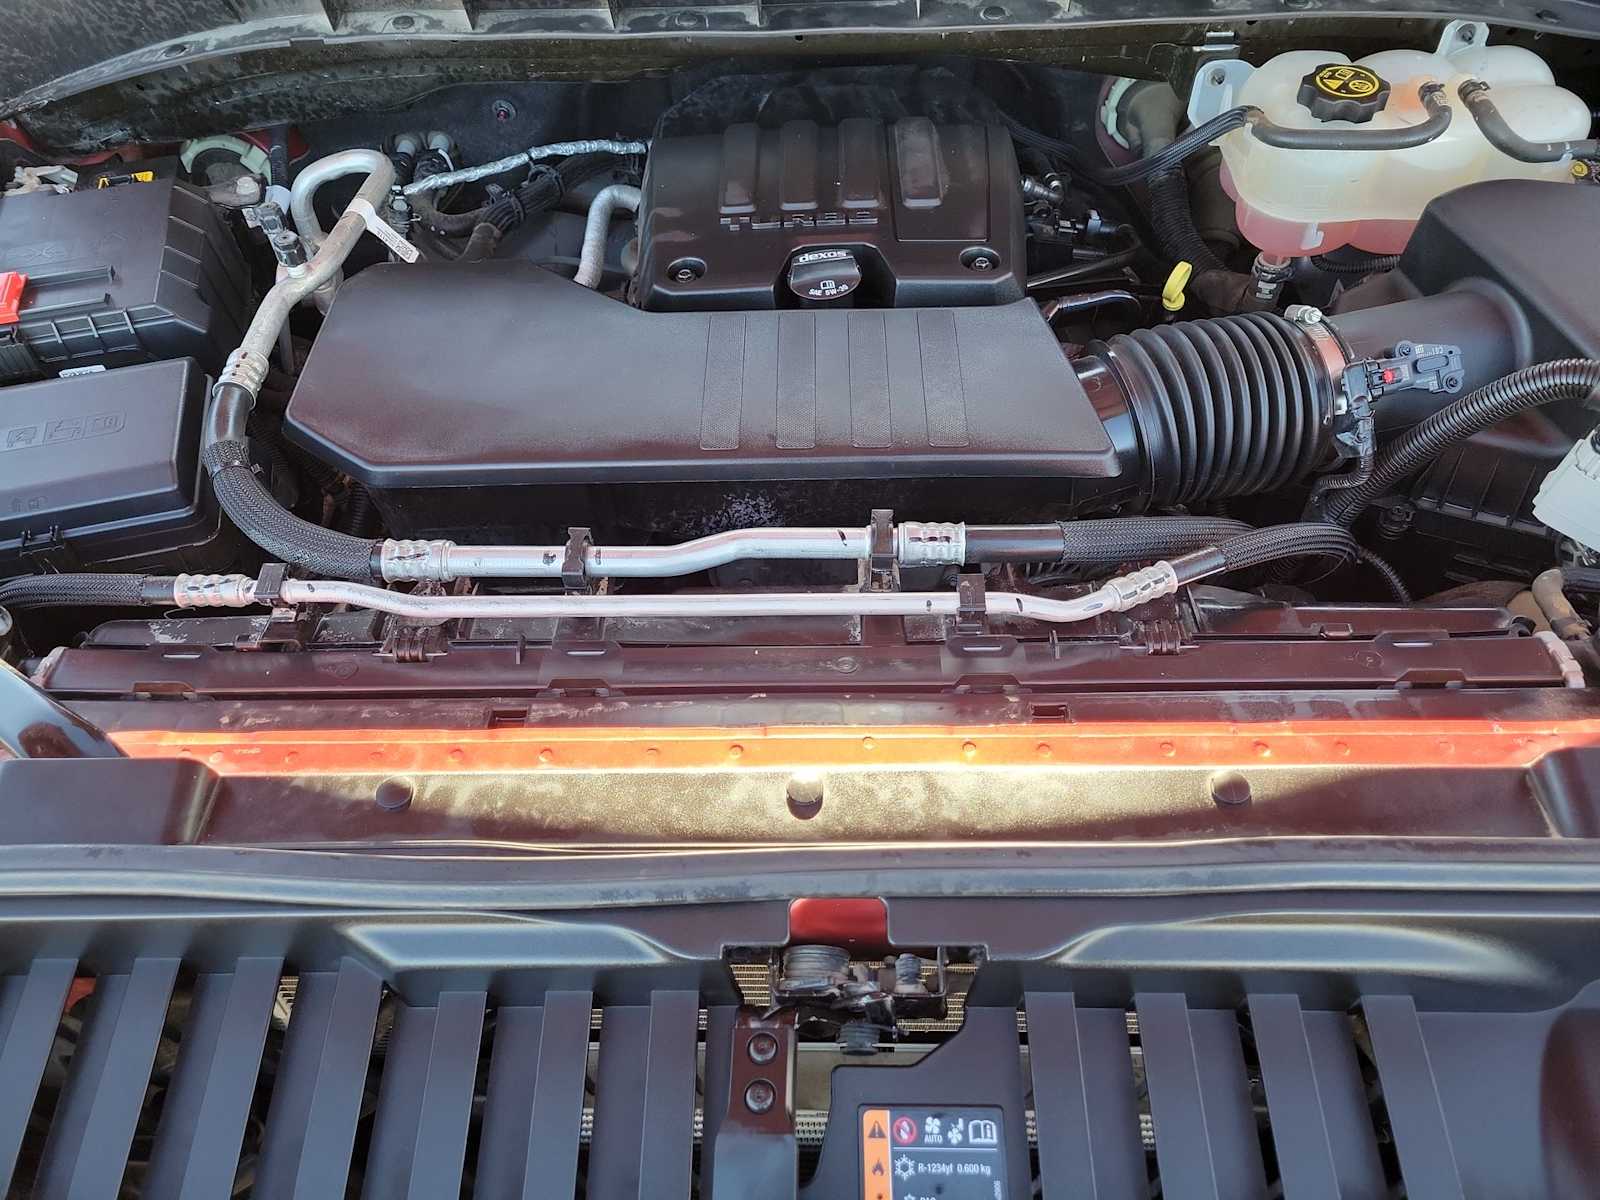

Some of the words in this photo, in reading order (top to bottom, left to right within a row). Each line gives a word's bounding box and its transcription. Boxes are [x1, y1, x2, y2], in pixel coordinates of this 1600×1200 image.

[798, 251, 847, 263] dexos
[808, 288, 823, 296] SAE
[924, 1134, 943, 1144] AUTO
[917, 1163, 953, 1176] R-1234yf
[957, 1163, 979, 1173] 0.600
[980, 1164, 991, 1176] kg
